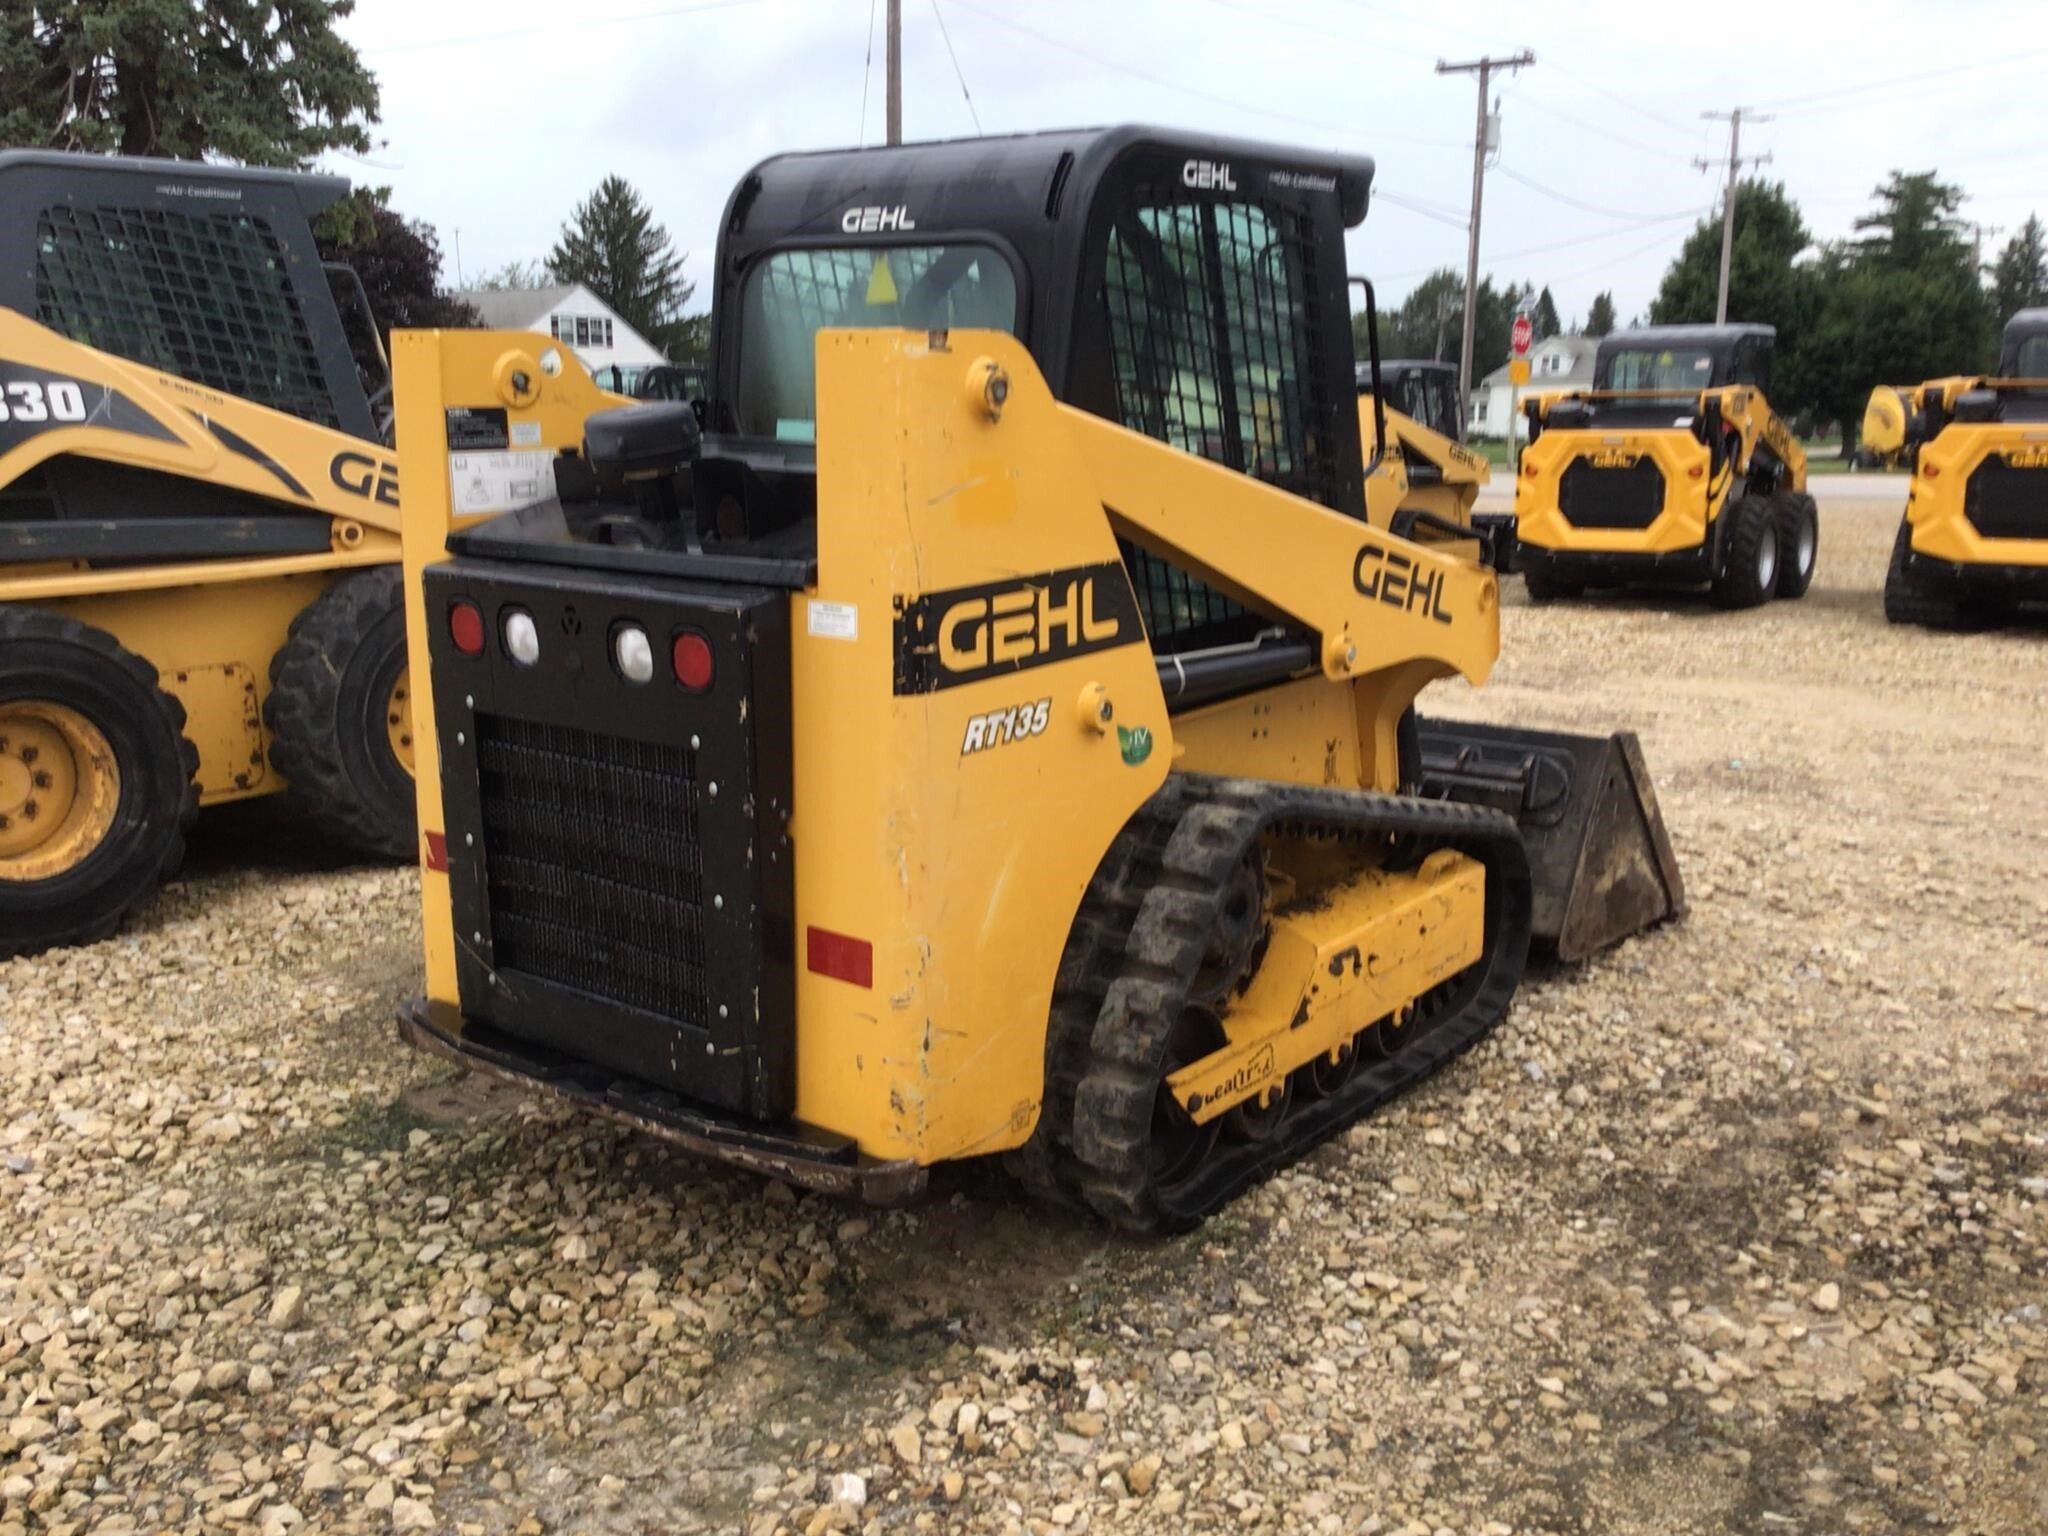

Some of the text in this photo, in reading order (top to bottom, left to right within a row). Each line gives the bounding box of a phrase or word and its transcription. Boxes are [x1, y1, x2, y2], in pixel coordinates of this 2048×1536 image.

[1183, 159, 1237, 191] GEHL
[842, 205, 915, 233] GEHL
[1514, 326, 1530, 346] STOP
[1448, 445, 1477, 471] GEHL
[1593, 454, 1632, 468] GEHL
[1353, 544, 1453, 625] GEHL
[938, 577, 1120, 673] GEHL
[960, 697, 1052, 757] RT135
